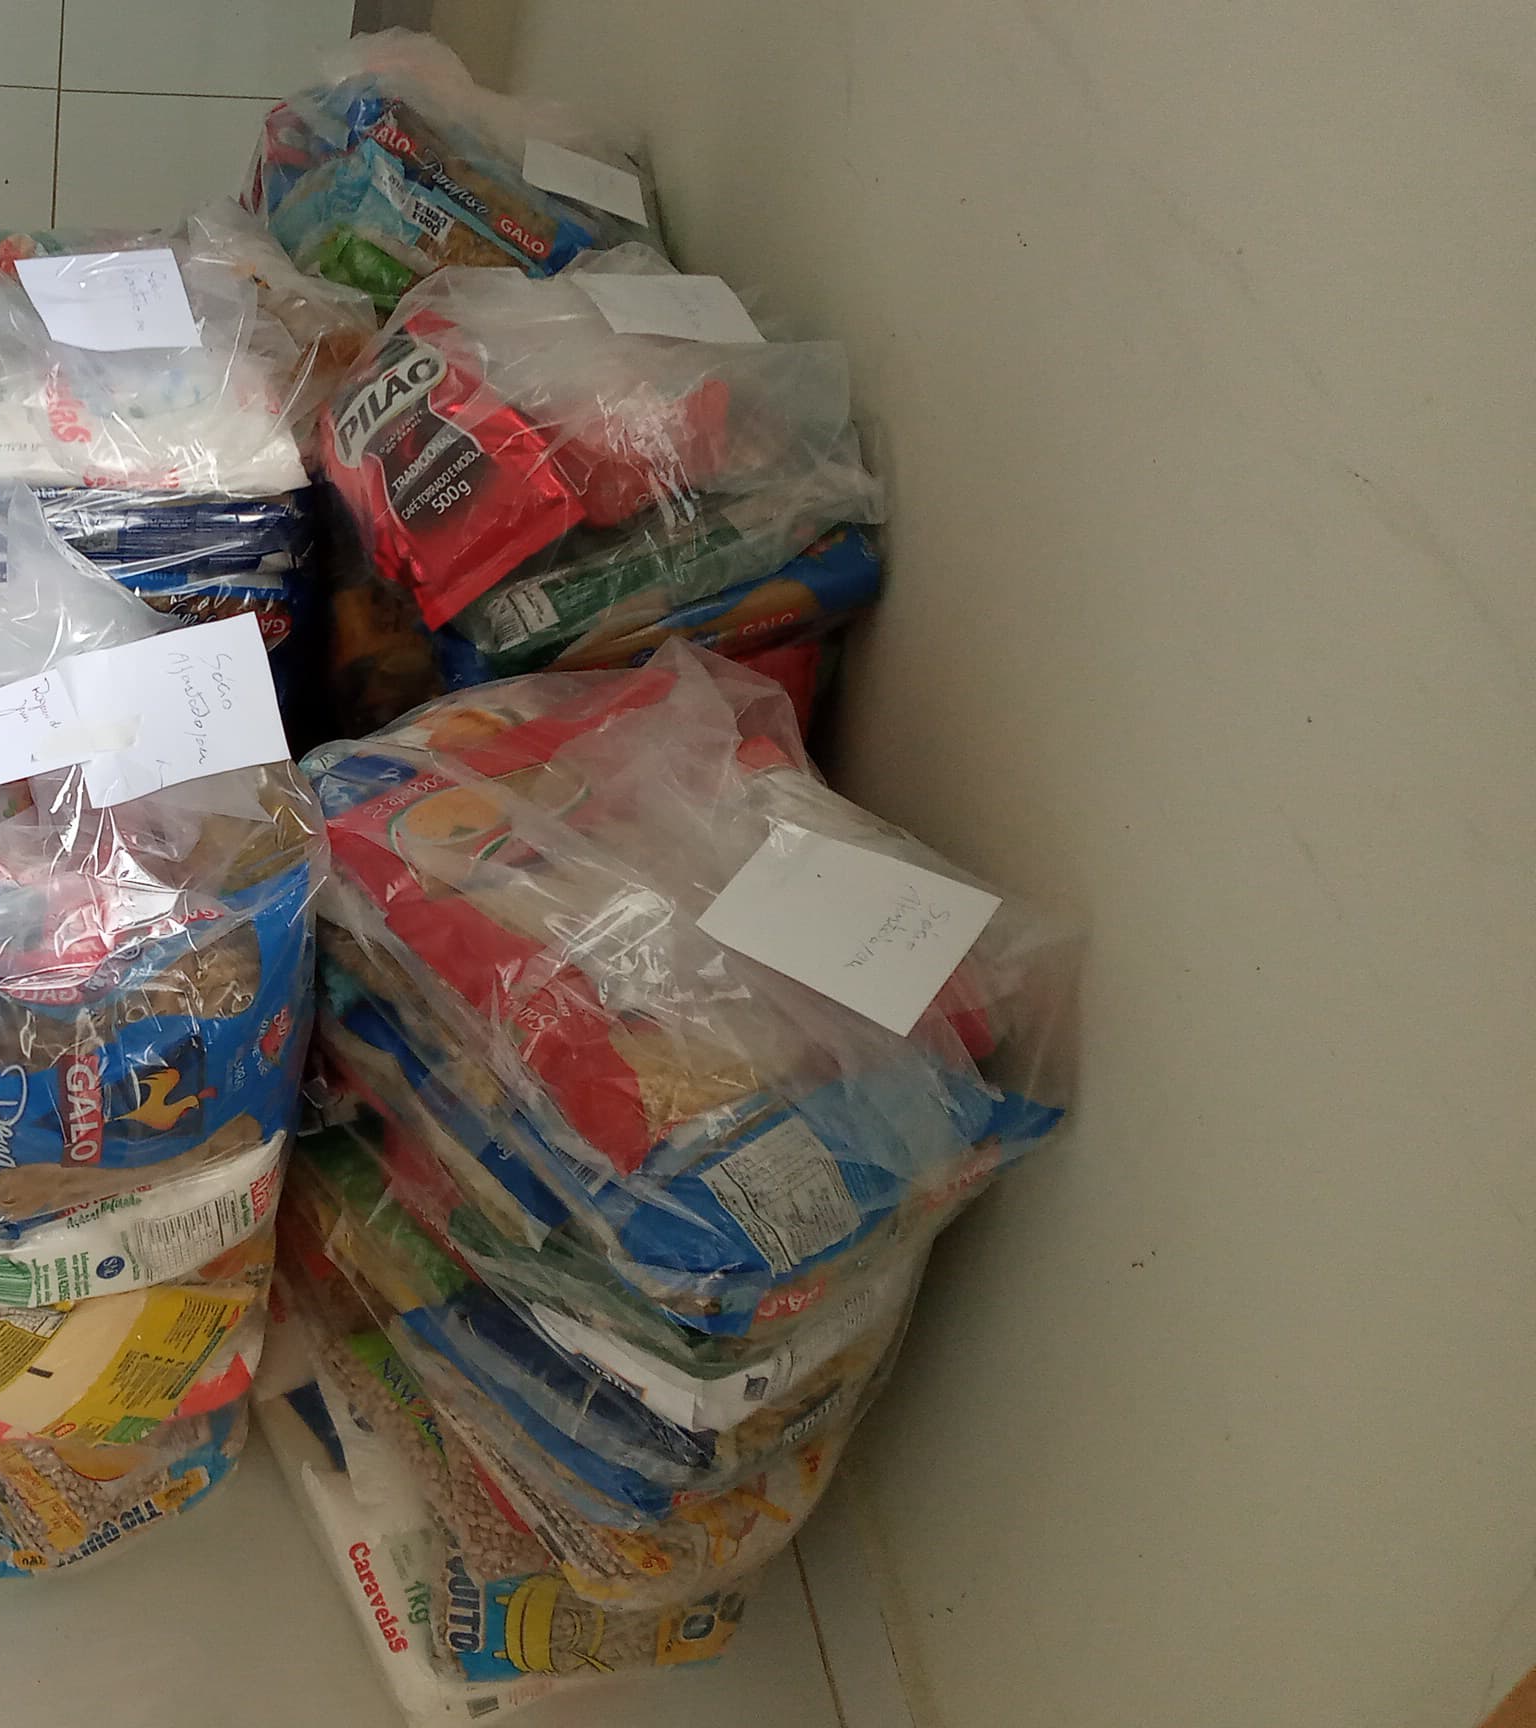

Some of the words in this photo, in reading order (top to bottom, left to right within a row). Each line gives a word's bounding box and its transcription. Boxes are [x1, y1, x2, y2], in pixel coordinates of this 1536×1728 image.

[499, 217, 546, 255] GALO
[391, 433, 458, 494] TRADICIONAL
[401, 498, 423, 521] CAFÉ
[417, 473, 453, 508] TORRADO
[430, 485, 461, 515] 500
[65, 1063, 100, 1163] GALO
[119, 1499, 164, 1532] TIO
[348, 1541, 409, 1654] Caravelas
[404, 1580, 433, 1626] 1kg
